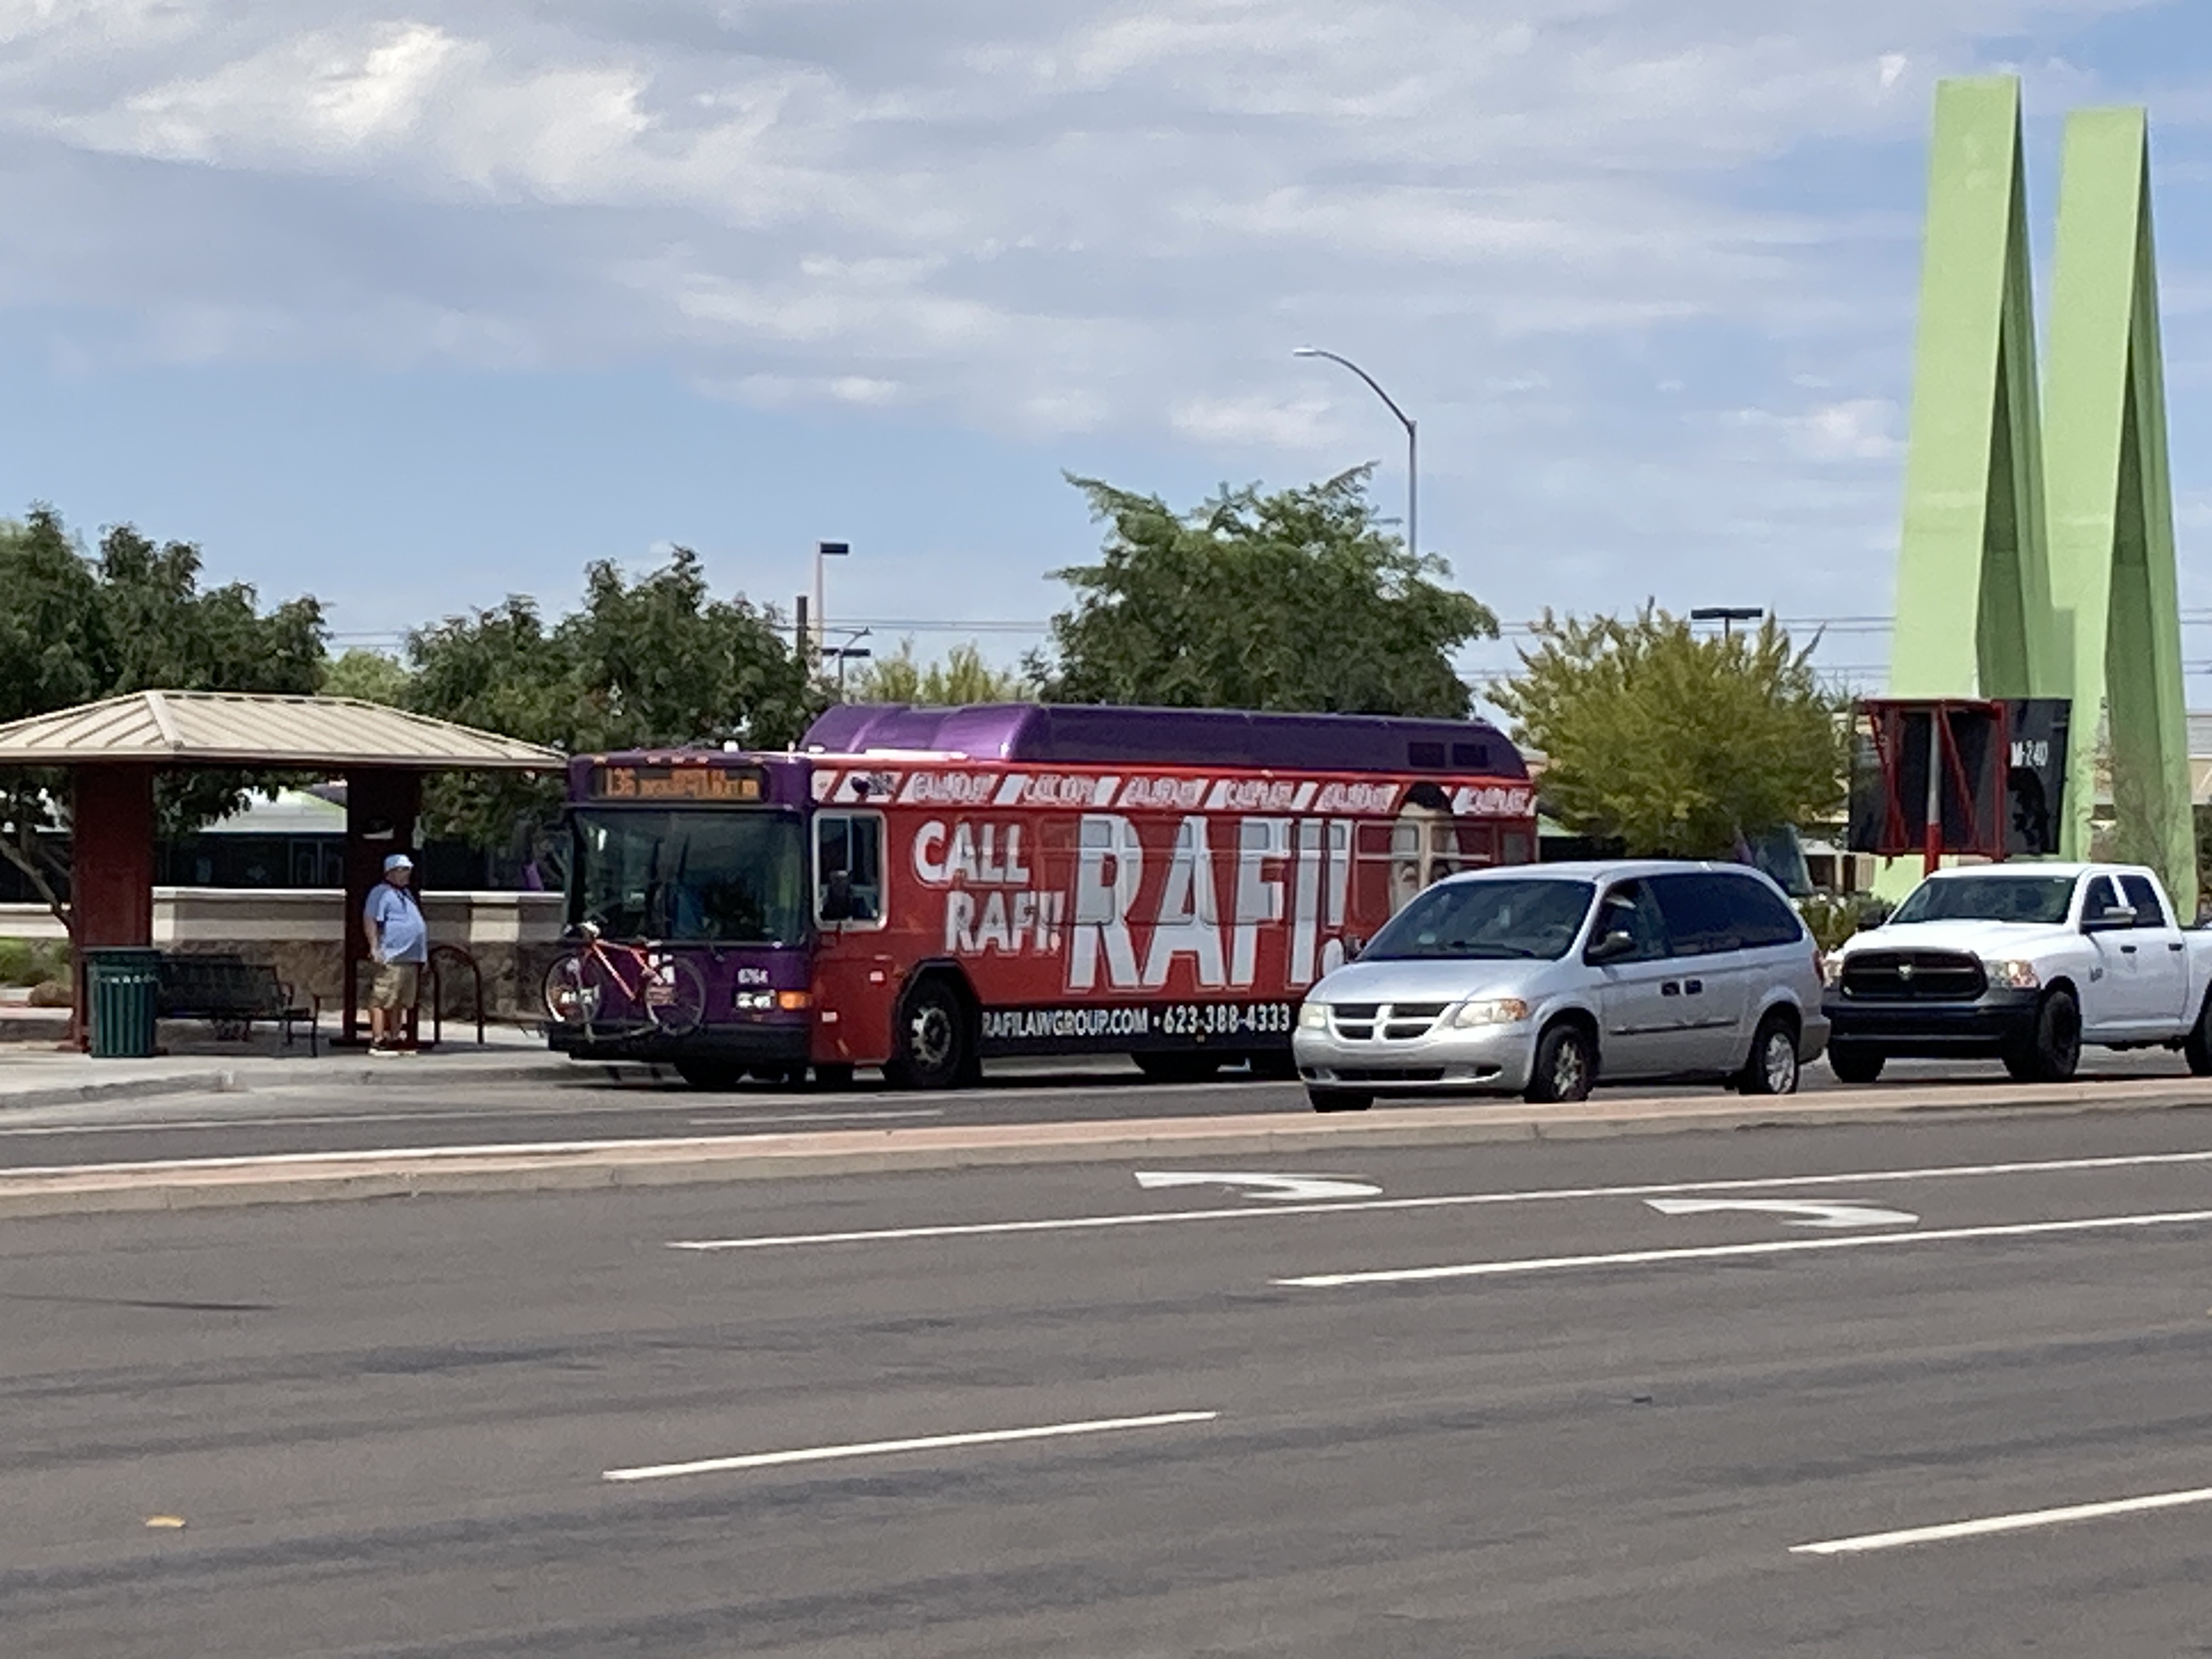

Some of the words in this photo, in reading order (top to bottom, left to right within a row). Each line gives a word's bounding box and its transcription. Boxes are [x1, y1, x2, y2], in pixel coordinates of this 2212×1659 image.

[915, 821, 1029, 883] CALL
[945, 890, 1065, 952] RAFI!
[1069, 814, 1353, 988] RAFI!
[982, 1008, 1148, 1037] RAFILAWGROUP.COM
[1163, 1003, 1289, 1033] 623-388-4333
